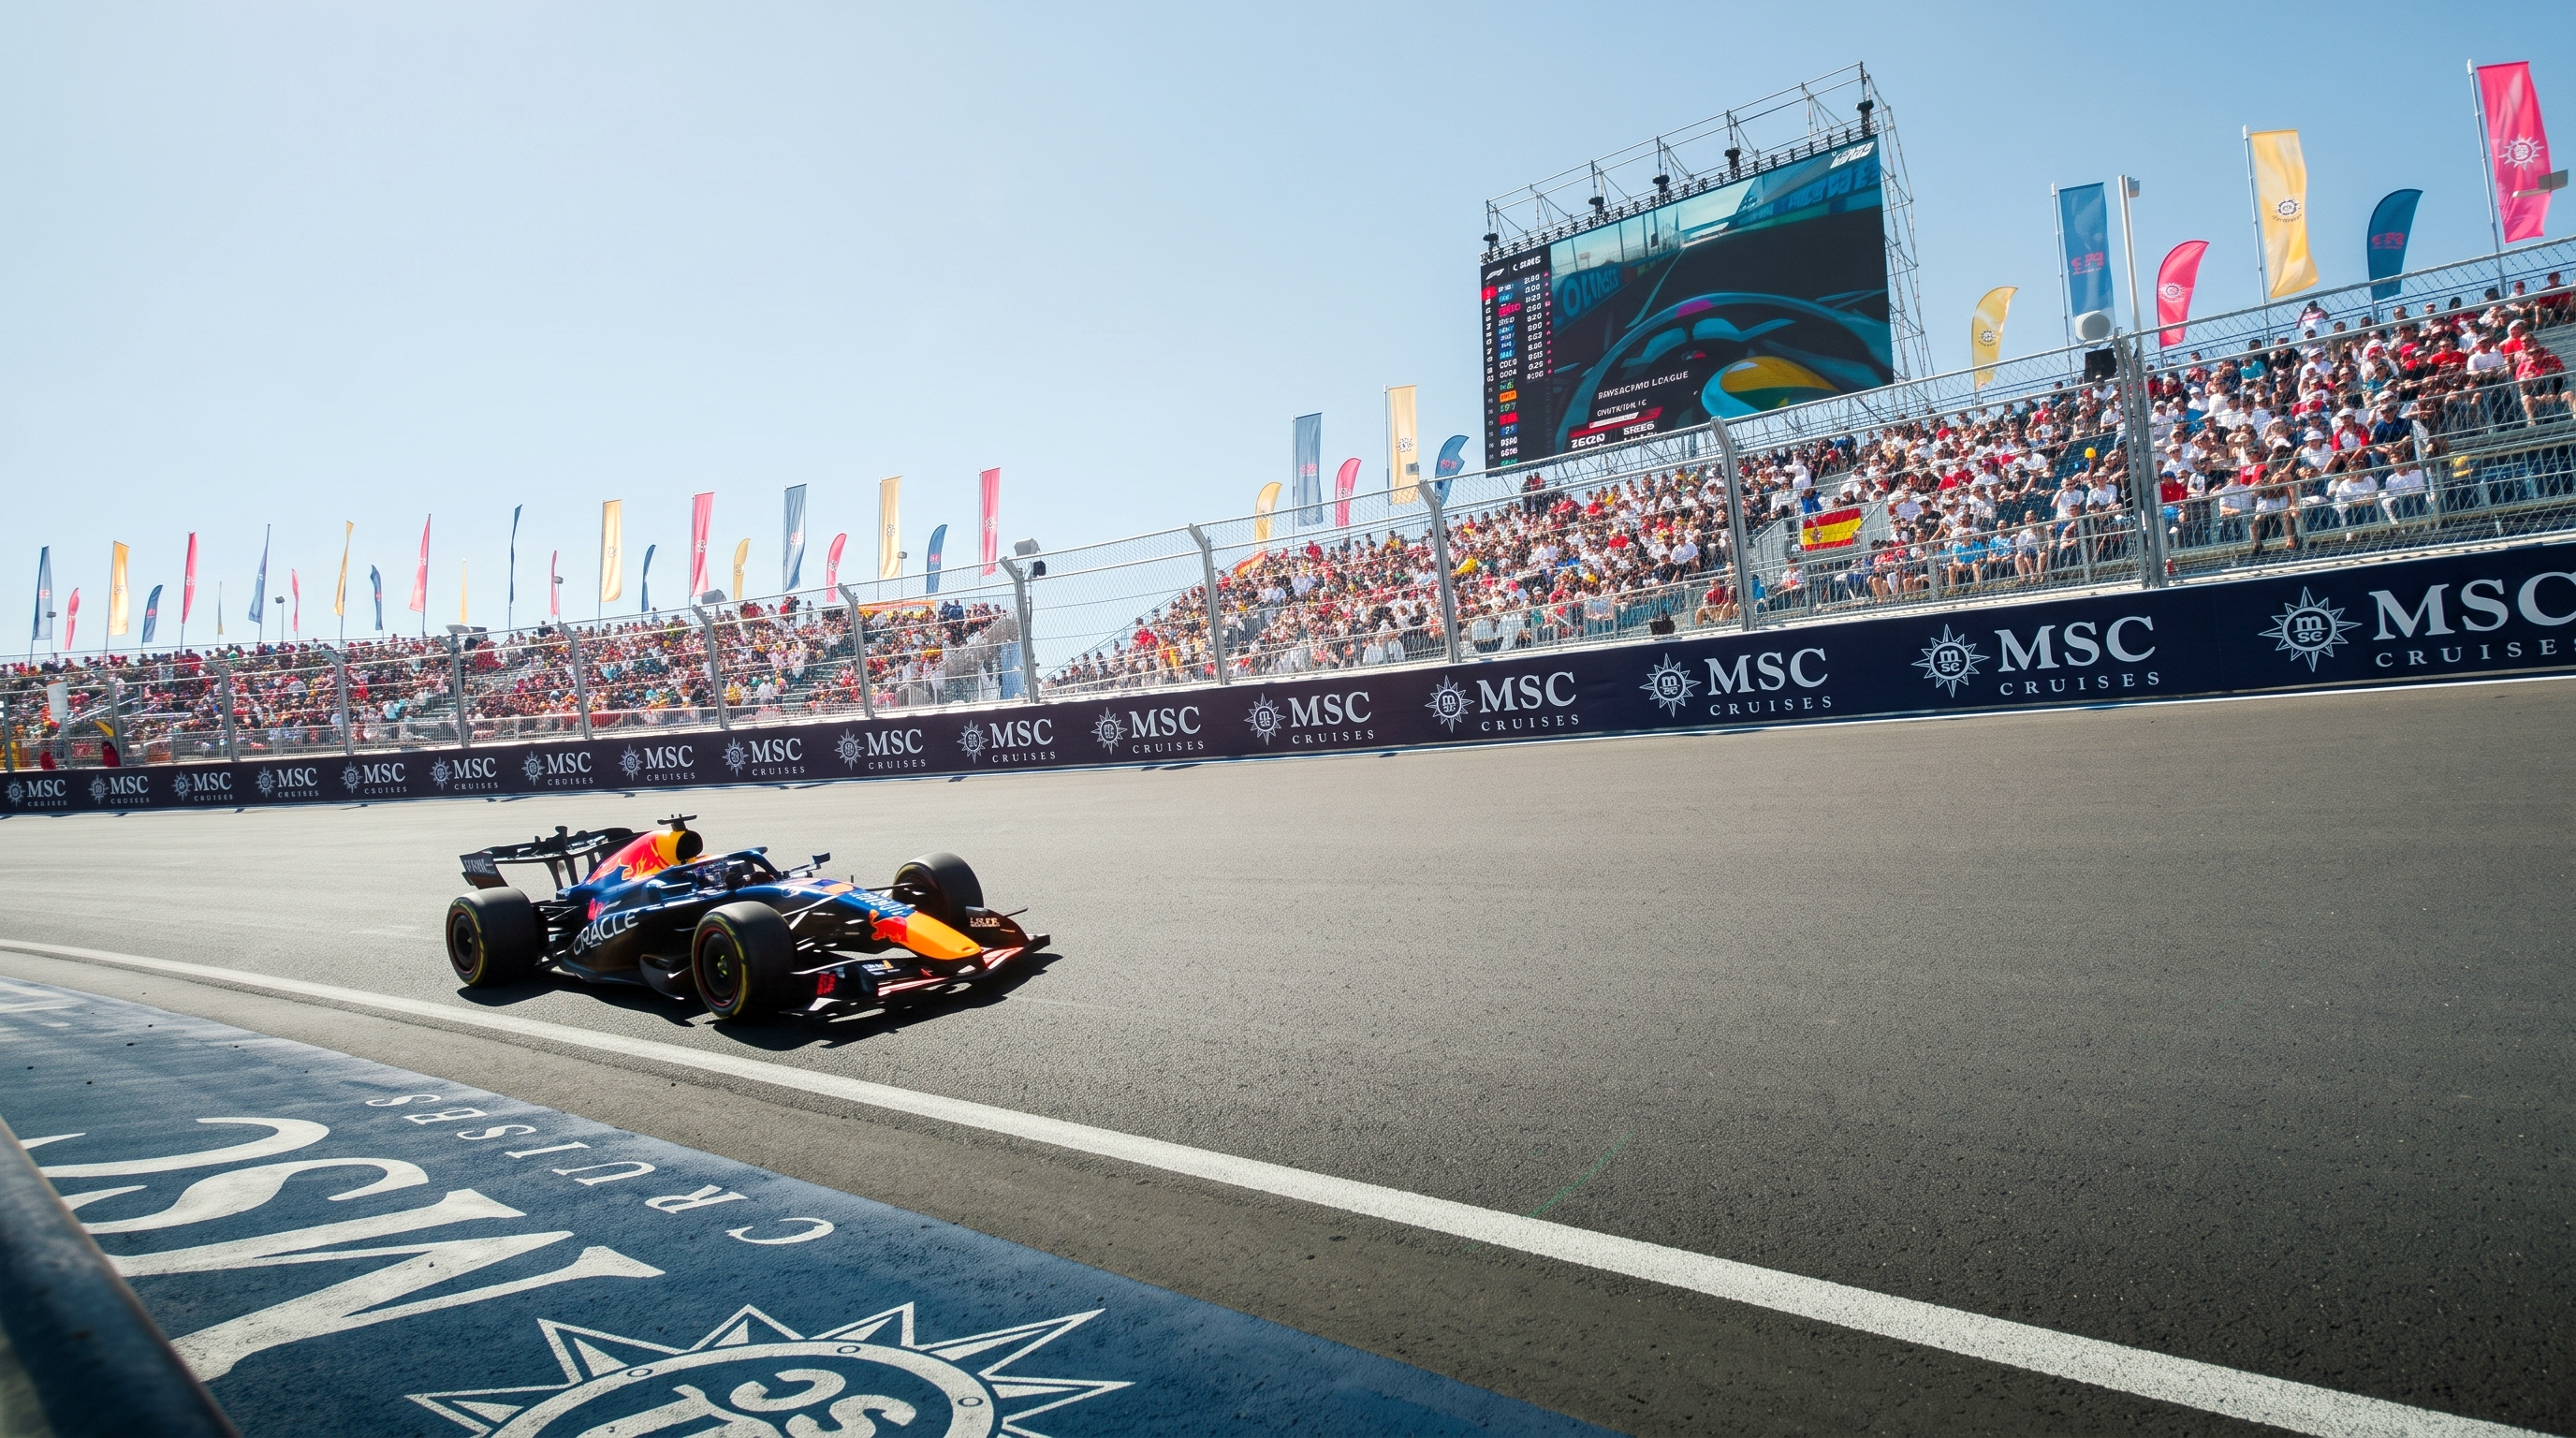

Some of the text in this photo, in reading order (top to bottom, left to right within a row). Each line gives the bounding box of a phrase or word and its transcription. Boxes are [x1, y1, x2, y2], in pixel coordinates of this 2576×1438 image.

[2368, 571, 2576, 640] MSC
[1994, 615, 2156, 673] MSC
[2375, 638, 2576, 668] CRUISE
[1704, 647, 1828, 696] MSC
[1476, 671, 1577, 713] MSC
[1999, 671, 2159, 696] CRUISES
[1288, 691, 1372, 728] MSC
[1709, 696, 1832, 716] CRUISES
[989, 718, 1054, 749] MSC
[1129, 706, 1202, 739] MSC
[1481, 714, 1579, 732] CRUISES
[866, 728, 924, 756] MSC
[1133, 740, 1204, 754] CRUISES
[1292, 729, 1374, 744] CRUISES
[644, 745, 695, 770] MSC
[749, 738, 803, 764] MSC
[992, 751, 1056, 763] CRUISES
[362, 763, 405, 784] MSC
[452, 757, 497, 779] MSC
[546, 752, 592, 775] MSC
[752, 766, 805, 776] CRUISES
[868, 758, 926, 770] CRUISES
[110, 776, 149, 795] MSC
[192, 772, 232, 791] MSC
[276, 768, 318, 788] MSC
[647, 771, 695, 782] CRUISES
[26, 779, 66, 798] MSC
[20, 1118, 666, 1384] MSC
